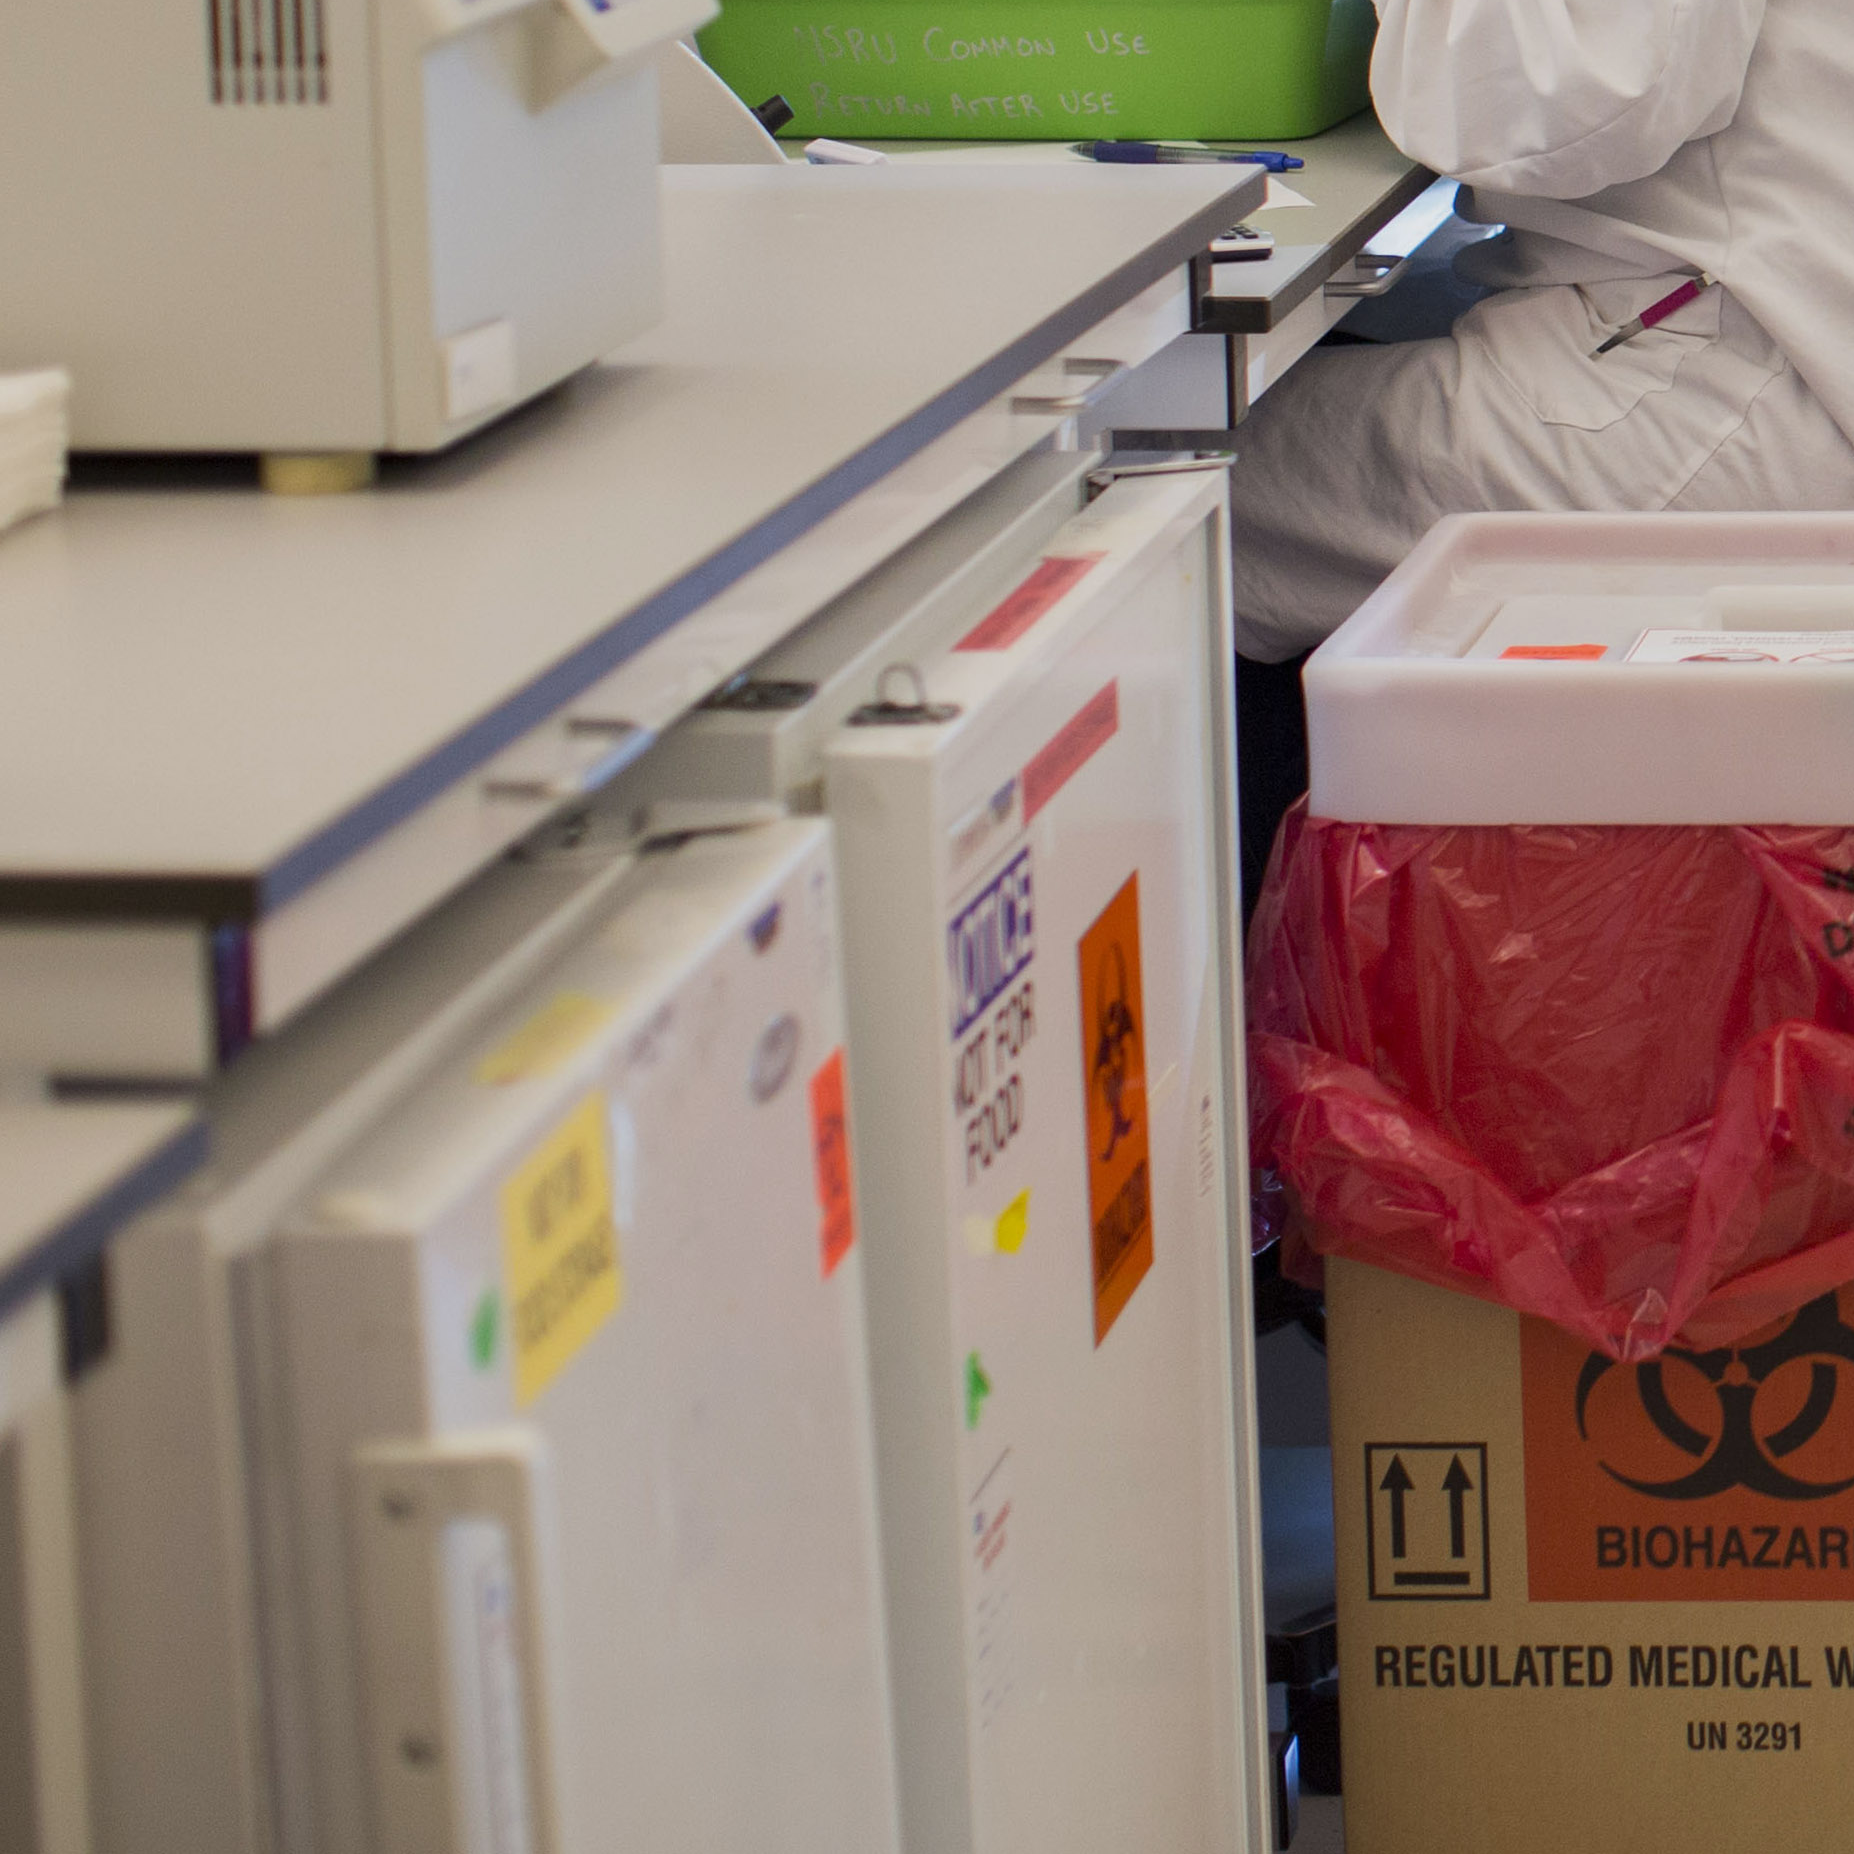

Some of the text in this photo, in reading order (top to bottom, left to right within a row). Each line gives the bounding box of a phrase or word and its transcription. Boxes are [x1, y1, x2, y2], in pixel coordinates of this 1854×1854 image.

[923, 26, 1055, 63] COMMON
[1085, 28, 1150, 56] USE
[809, 81, 1119, 119] RETURN AFTER USE
[966, 1073, 1023, 1186] FOOD
[1374, 1644, 1613, 1689] REGULATED
[1629, 1645, 1812, 1690] MEDICAL
[1687, 1722, 1803, 1752] UN 3291
